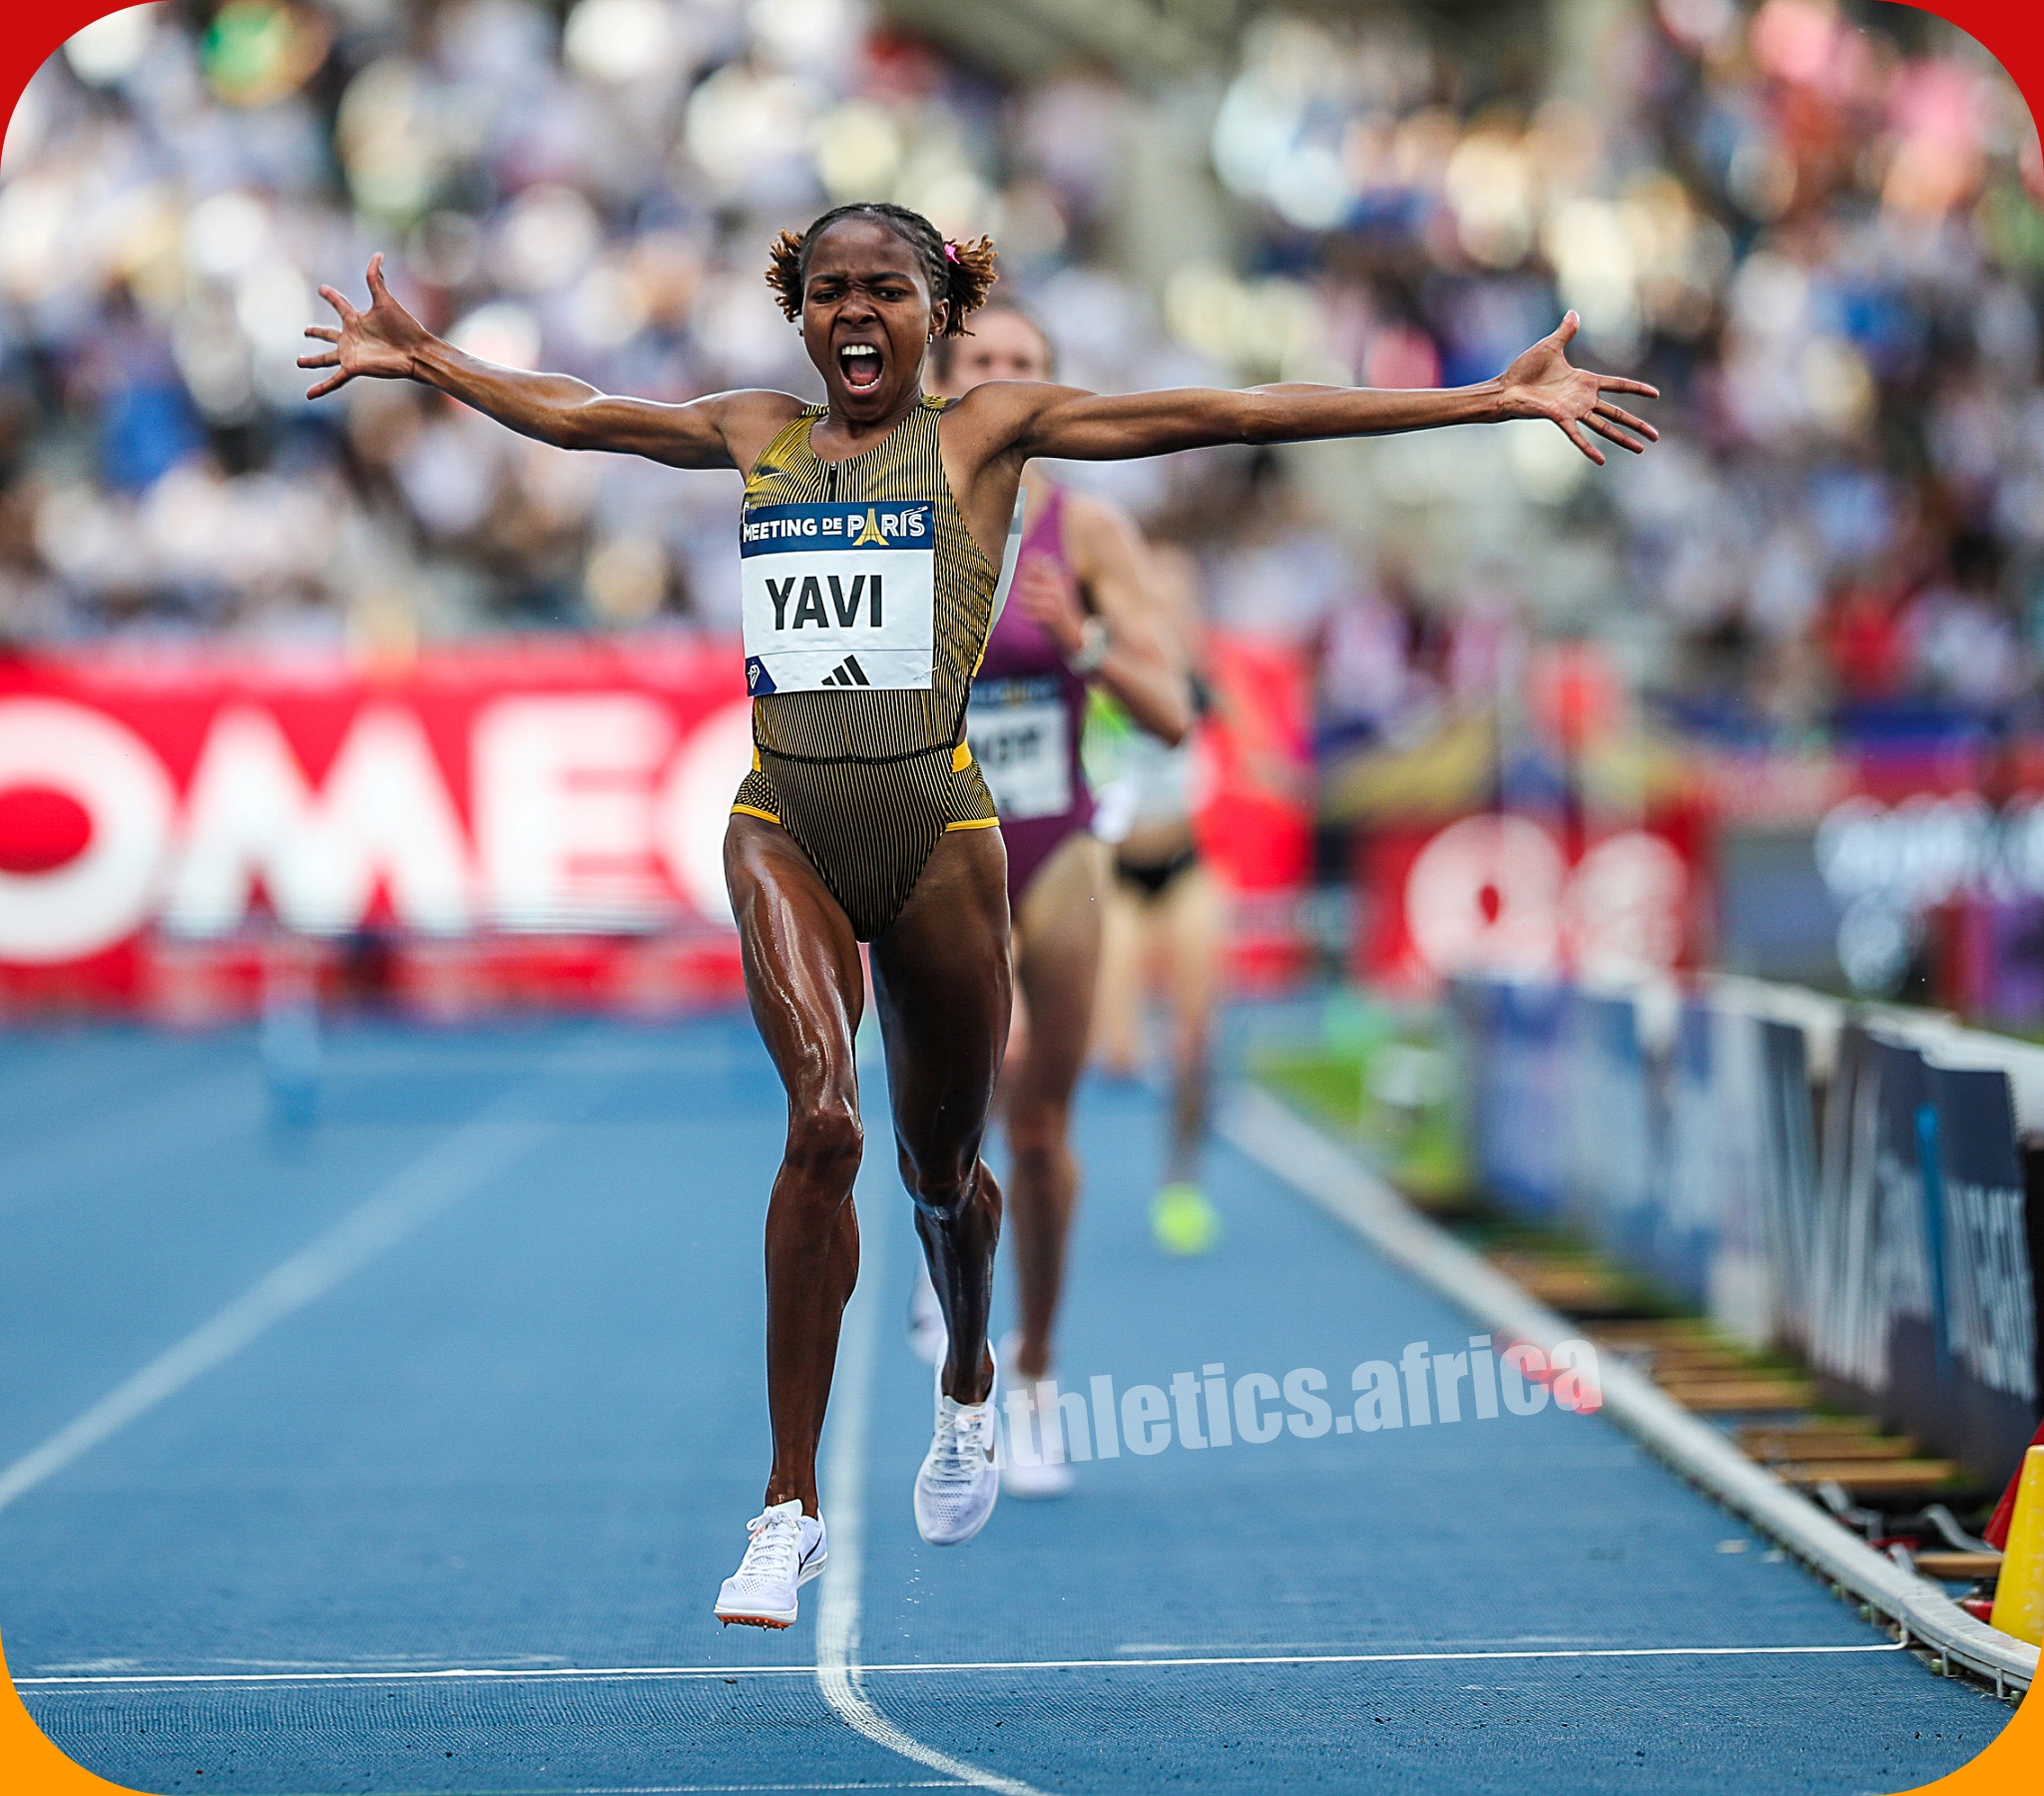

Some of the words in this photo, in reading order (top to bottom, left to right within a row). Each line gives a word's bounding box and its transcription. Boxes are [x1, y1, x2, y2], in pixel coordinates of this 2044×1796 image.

[743, 517, 818, 544] MEETING
[821, 517, 843, 536] DE
[846, 507, 929, 547] PARIS
[765, 574, 883, 631] YAVI
[0, 692, 751, 966] OME
